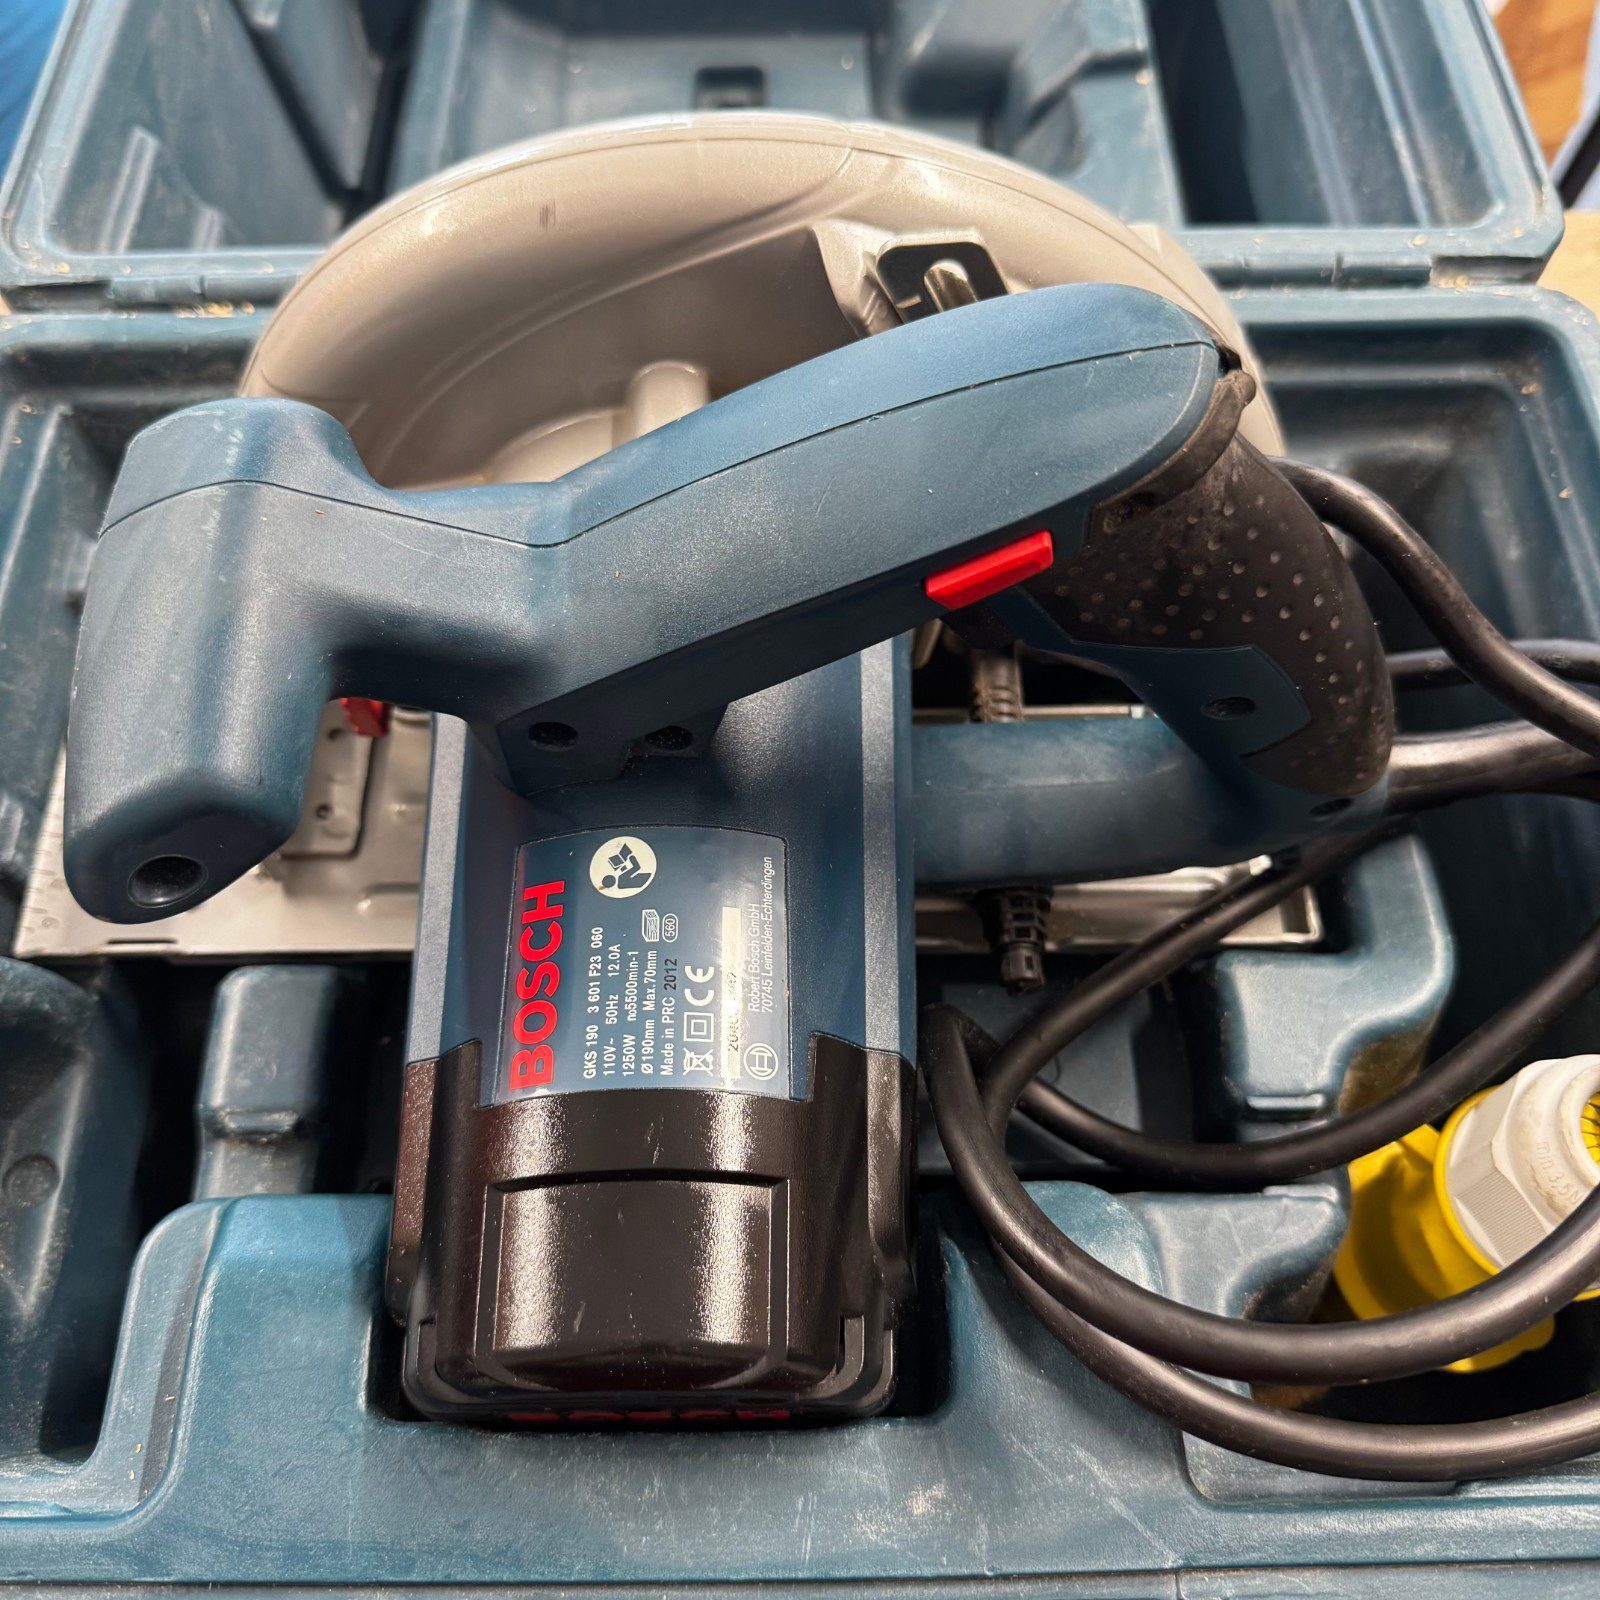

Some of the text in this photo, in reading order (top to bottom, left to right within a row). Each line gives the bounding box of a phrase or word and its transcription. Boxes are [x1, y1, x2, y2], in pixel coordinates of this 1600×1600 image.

[607, 944, 621, 977] 12.0A
[664, 918, 676, 937] 560
[747, 902, 760, 1012] Robert Bosch GmbH
[760, 856, 775, 1013] 70745 Leinfelden-Echterdingen
[509, 880, 565, 1091] BOSCH
[583, 927, 604, 1079] GKS 190 3 601 F23 060
[605, 994, 619, 1025] 50Hz
[643, 950, 658, 1011] Max.70mm
[660, 958, 678, 1076] Made in PRC 2012
[622, 1034, 636, 1076] 1250W
